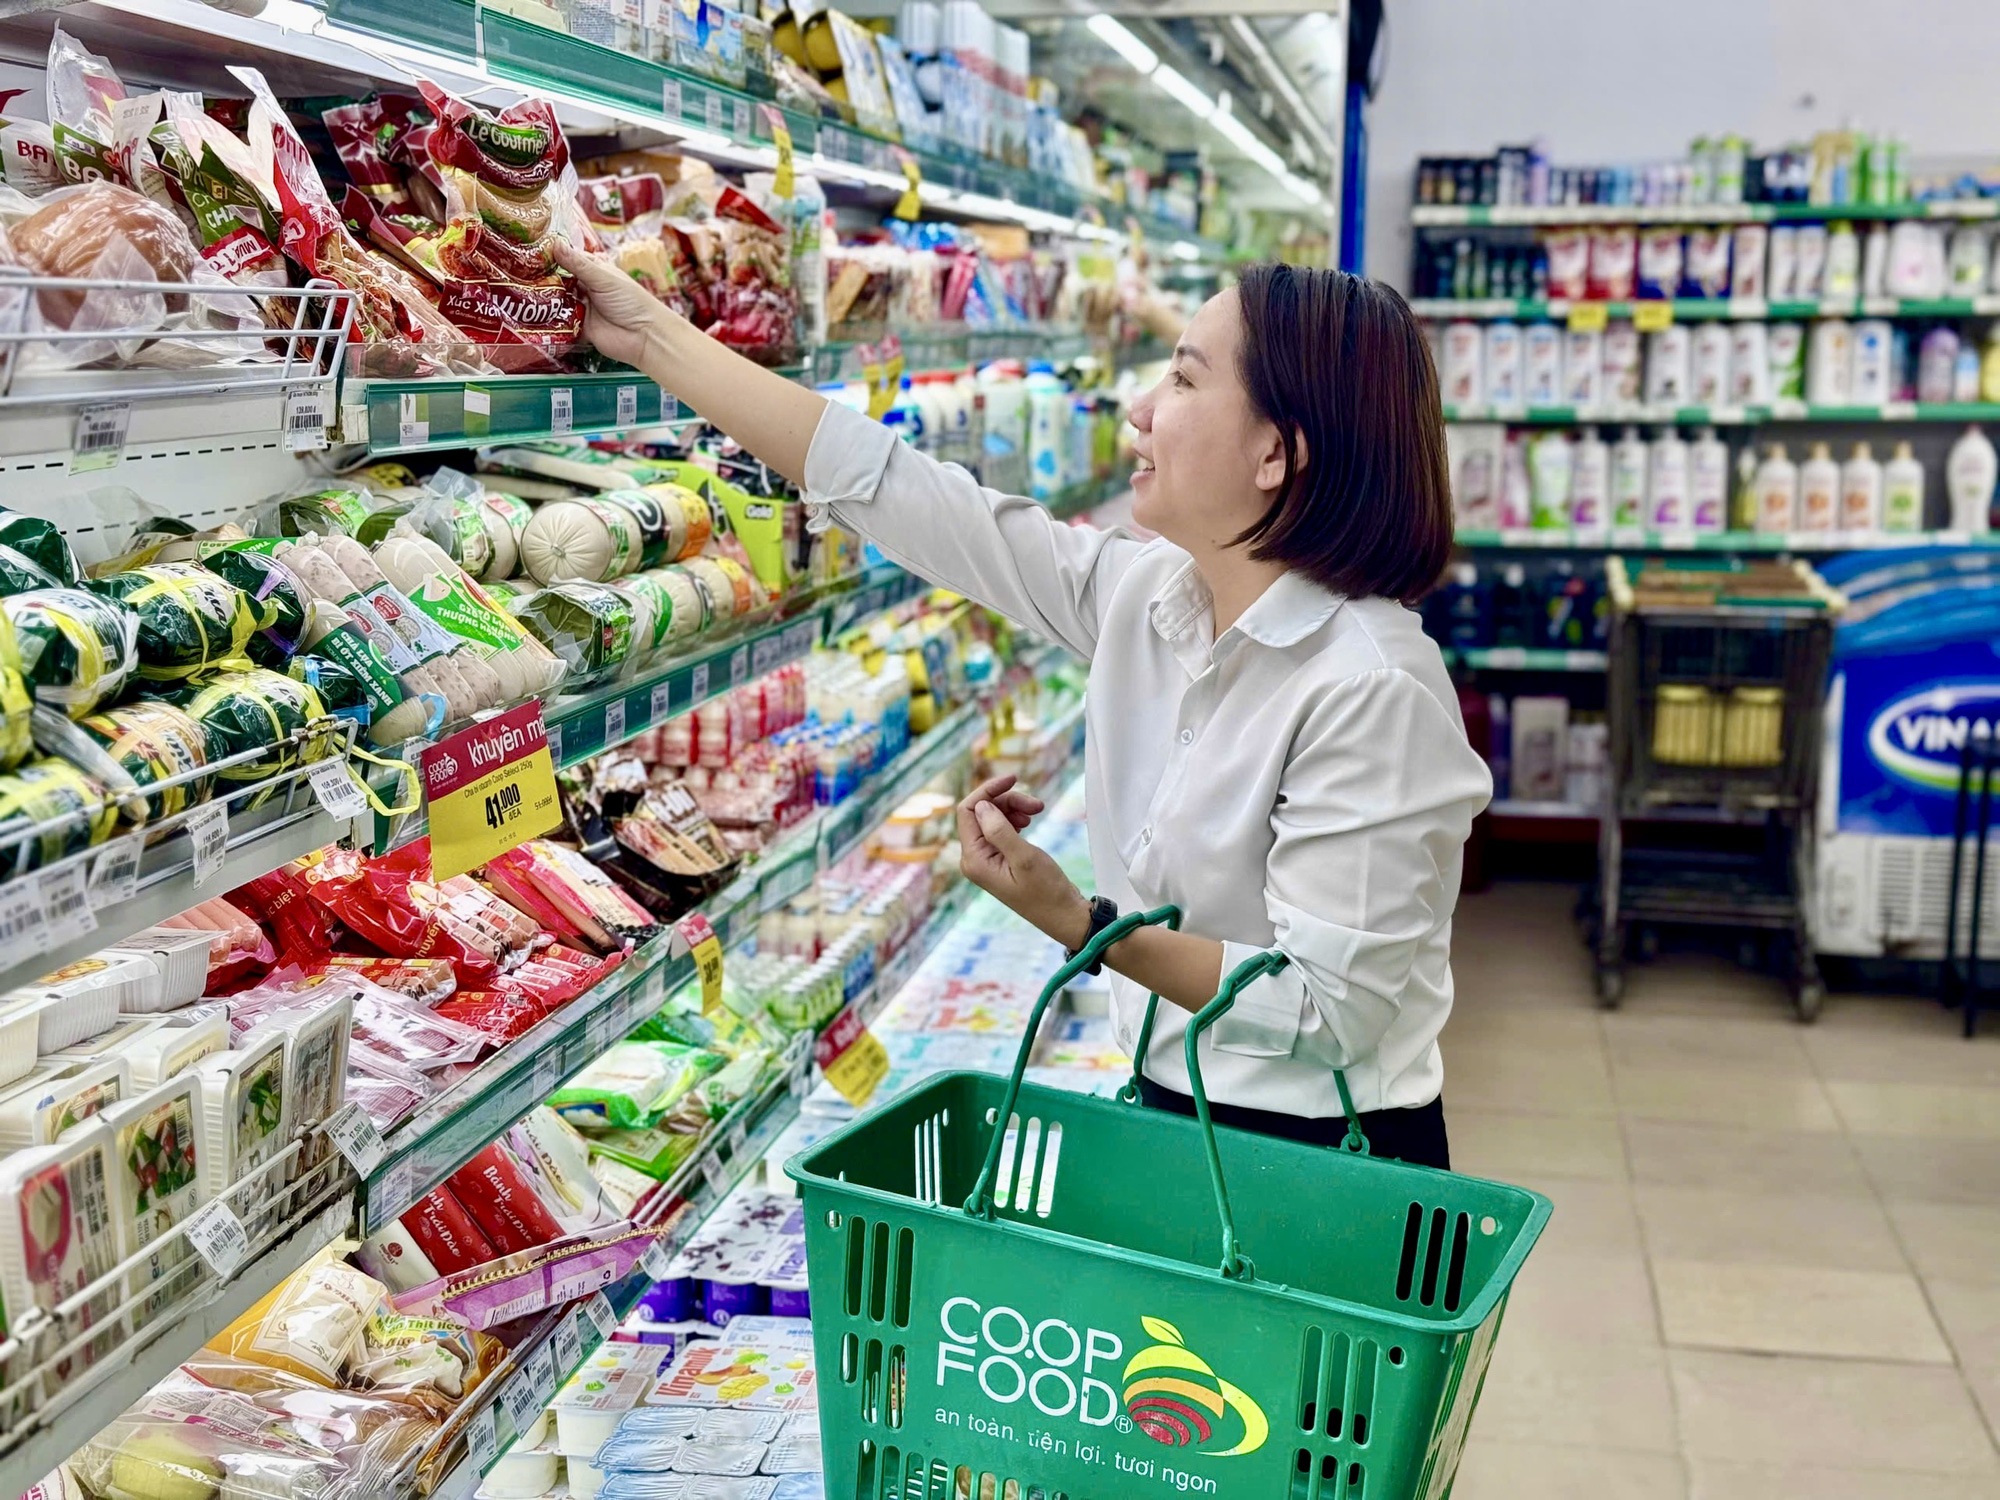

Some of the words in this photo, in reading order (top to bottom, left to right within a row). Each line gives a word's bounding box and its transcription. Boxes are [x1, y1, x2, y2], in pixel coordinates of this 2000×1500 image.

[273, 887, 297, 914] biệt
[482, 1164, 513, 1203] Bánh
[423, 1204, 447, 1233] Trái
[408, 1319, 434, 1331] Thịt
[654, 1346, 723, 1398] Vinamilk
[936, 1341, 1118, 1427] FOOD
[934, 1407, 960, 1427] an
[1027, 1429, 1067, 1455] tiện
[1114, 1450, 1156, 1479] tươi
[1162, 1466, 1218, 1495] ngon
